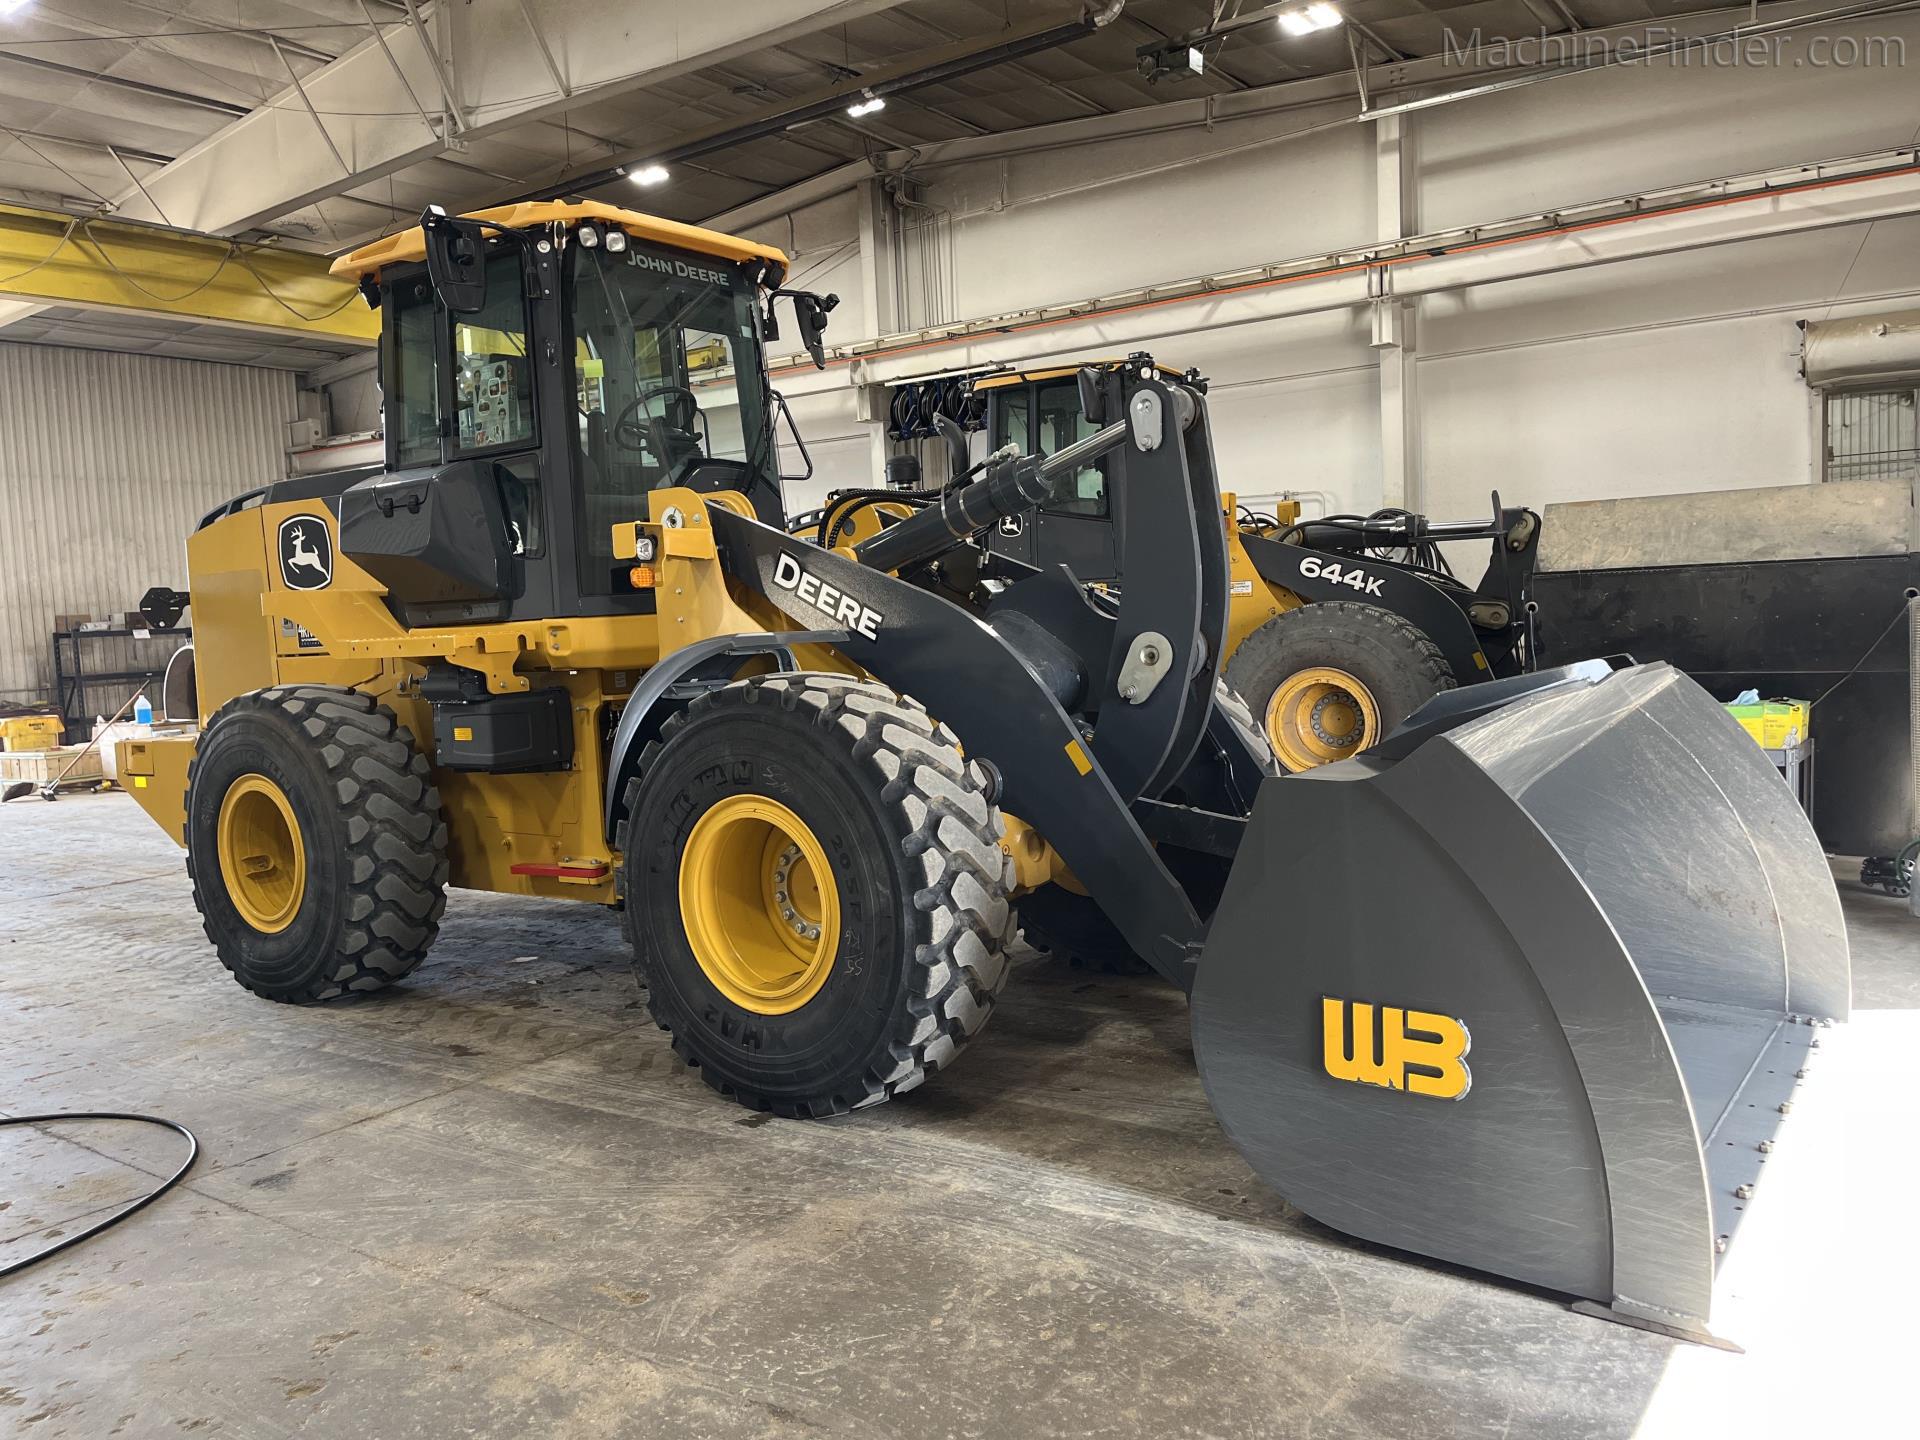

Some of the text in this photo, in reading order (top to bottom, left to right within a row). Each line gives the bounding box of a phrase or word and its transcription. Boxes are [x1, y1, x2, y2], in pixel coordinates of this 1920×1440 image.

[627, 250, 730, 286] JOHN DEERE
[773, 552, 883, 641] DEERE
[1299, 556, 1386, 598] 644K
[1323, 997, 1472, 1101] WB
